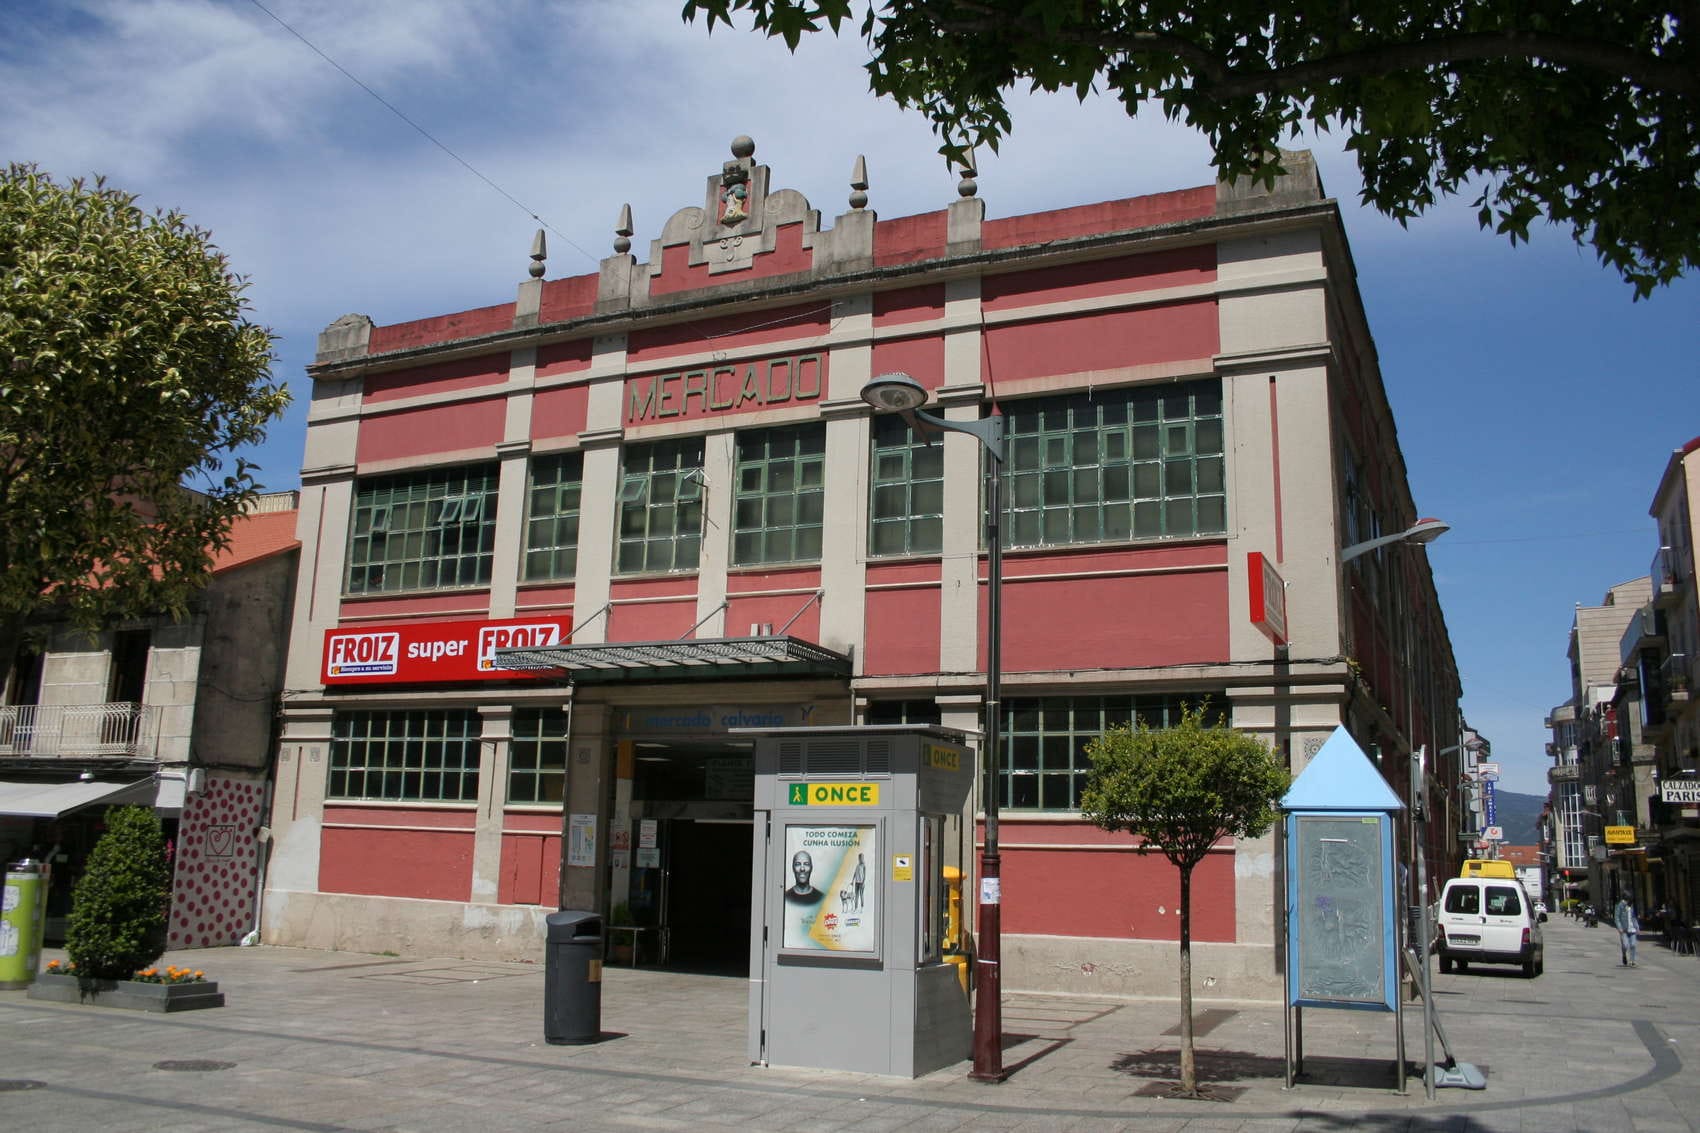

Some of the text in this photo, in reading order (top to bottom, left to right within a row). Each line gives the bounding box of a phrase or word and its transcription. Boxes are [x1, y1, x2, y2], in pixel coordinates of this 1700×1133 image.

[629, 353, 822, 423] MERCADO
[332, 627, 555, 664] FROIZ super FROIZ
[647, 710, 784, 728] mercado calvario
[934, 749, 957, 768] ONCE
[815, 786, 872, 802] ONCE
[1667, 791, 1700, 801] PARIS
